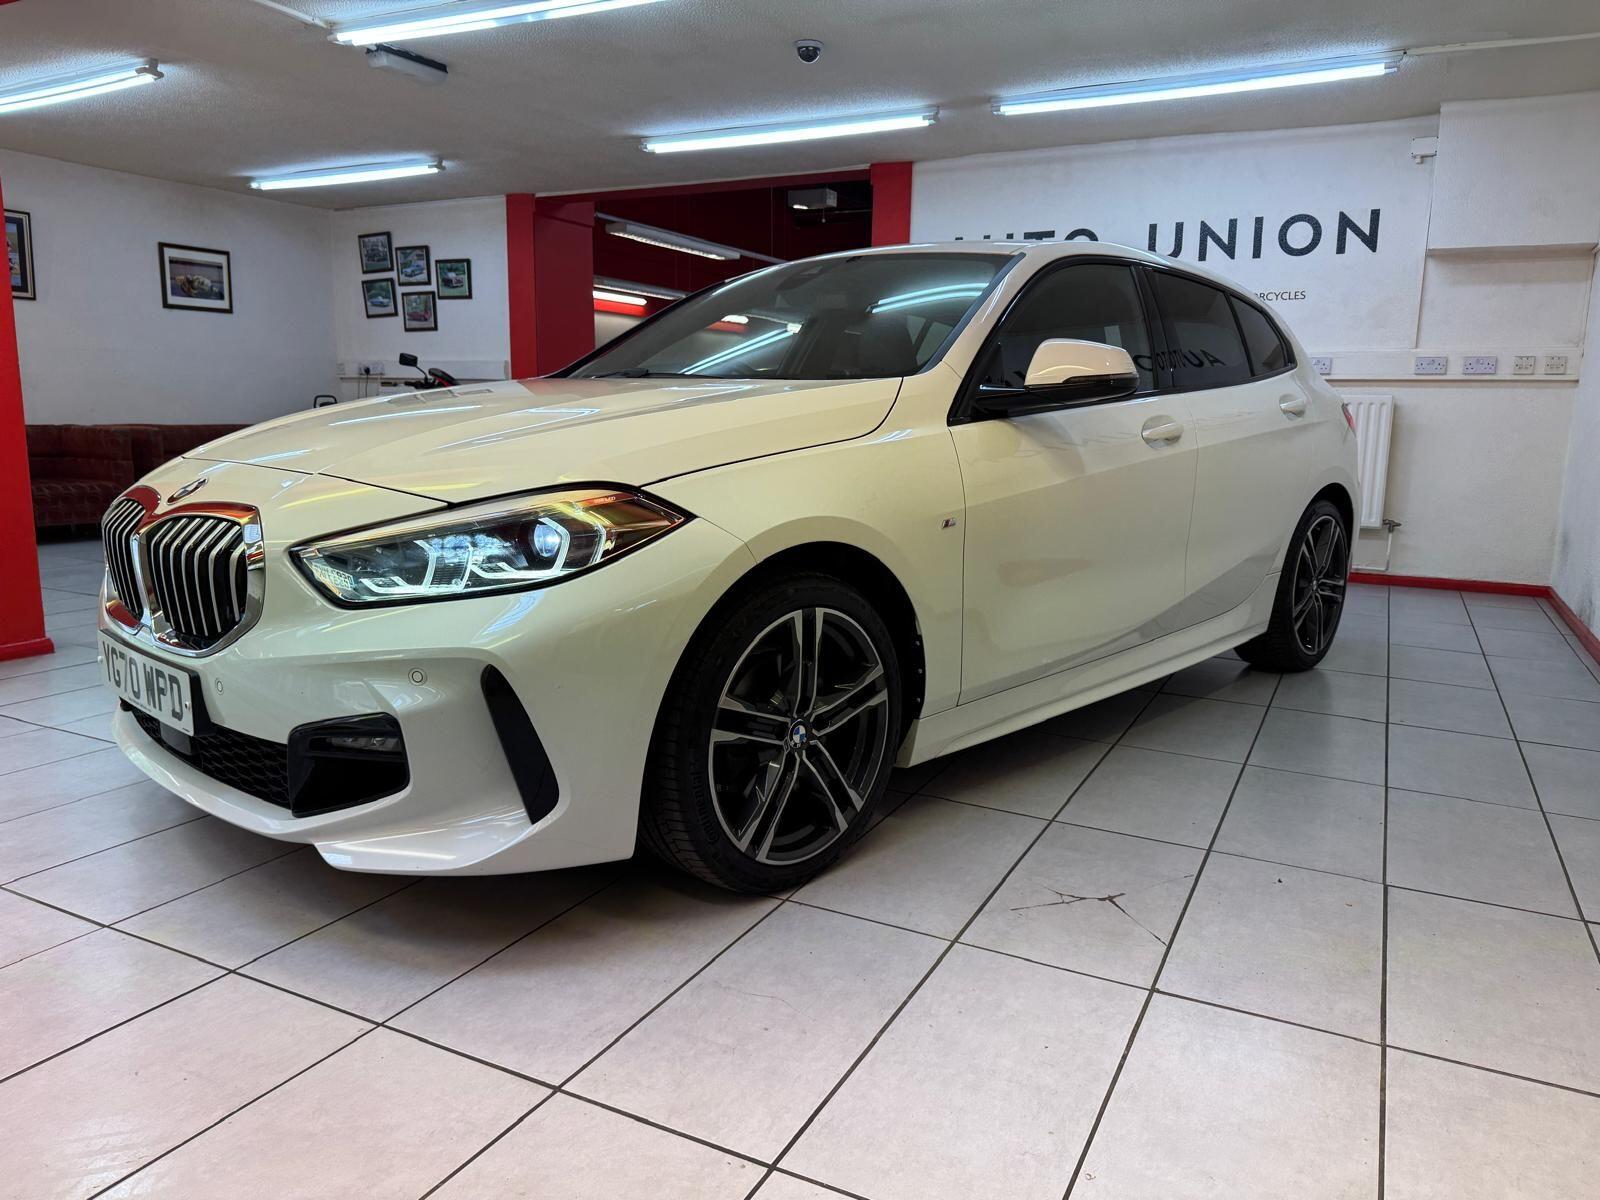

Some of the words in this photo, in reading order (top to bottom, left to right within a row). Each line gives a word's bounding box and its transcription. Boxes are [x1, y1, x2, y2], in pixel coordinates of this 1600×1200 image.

[1148, 208, 1381, 262] UNION
[1255, 290, 1306, 301] RCYCLES
[102, 641, 141, 700] YG70
[143, 662, 184, 722] WPD
